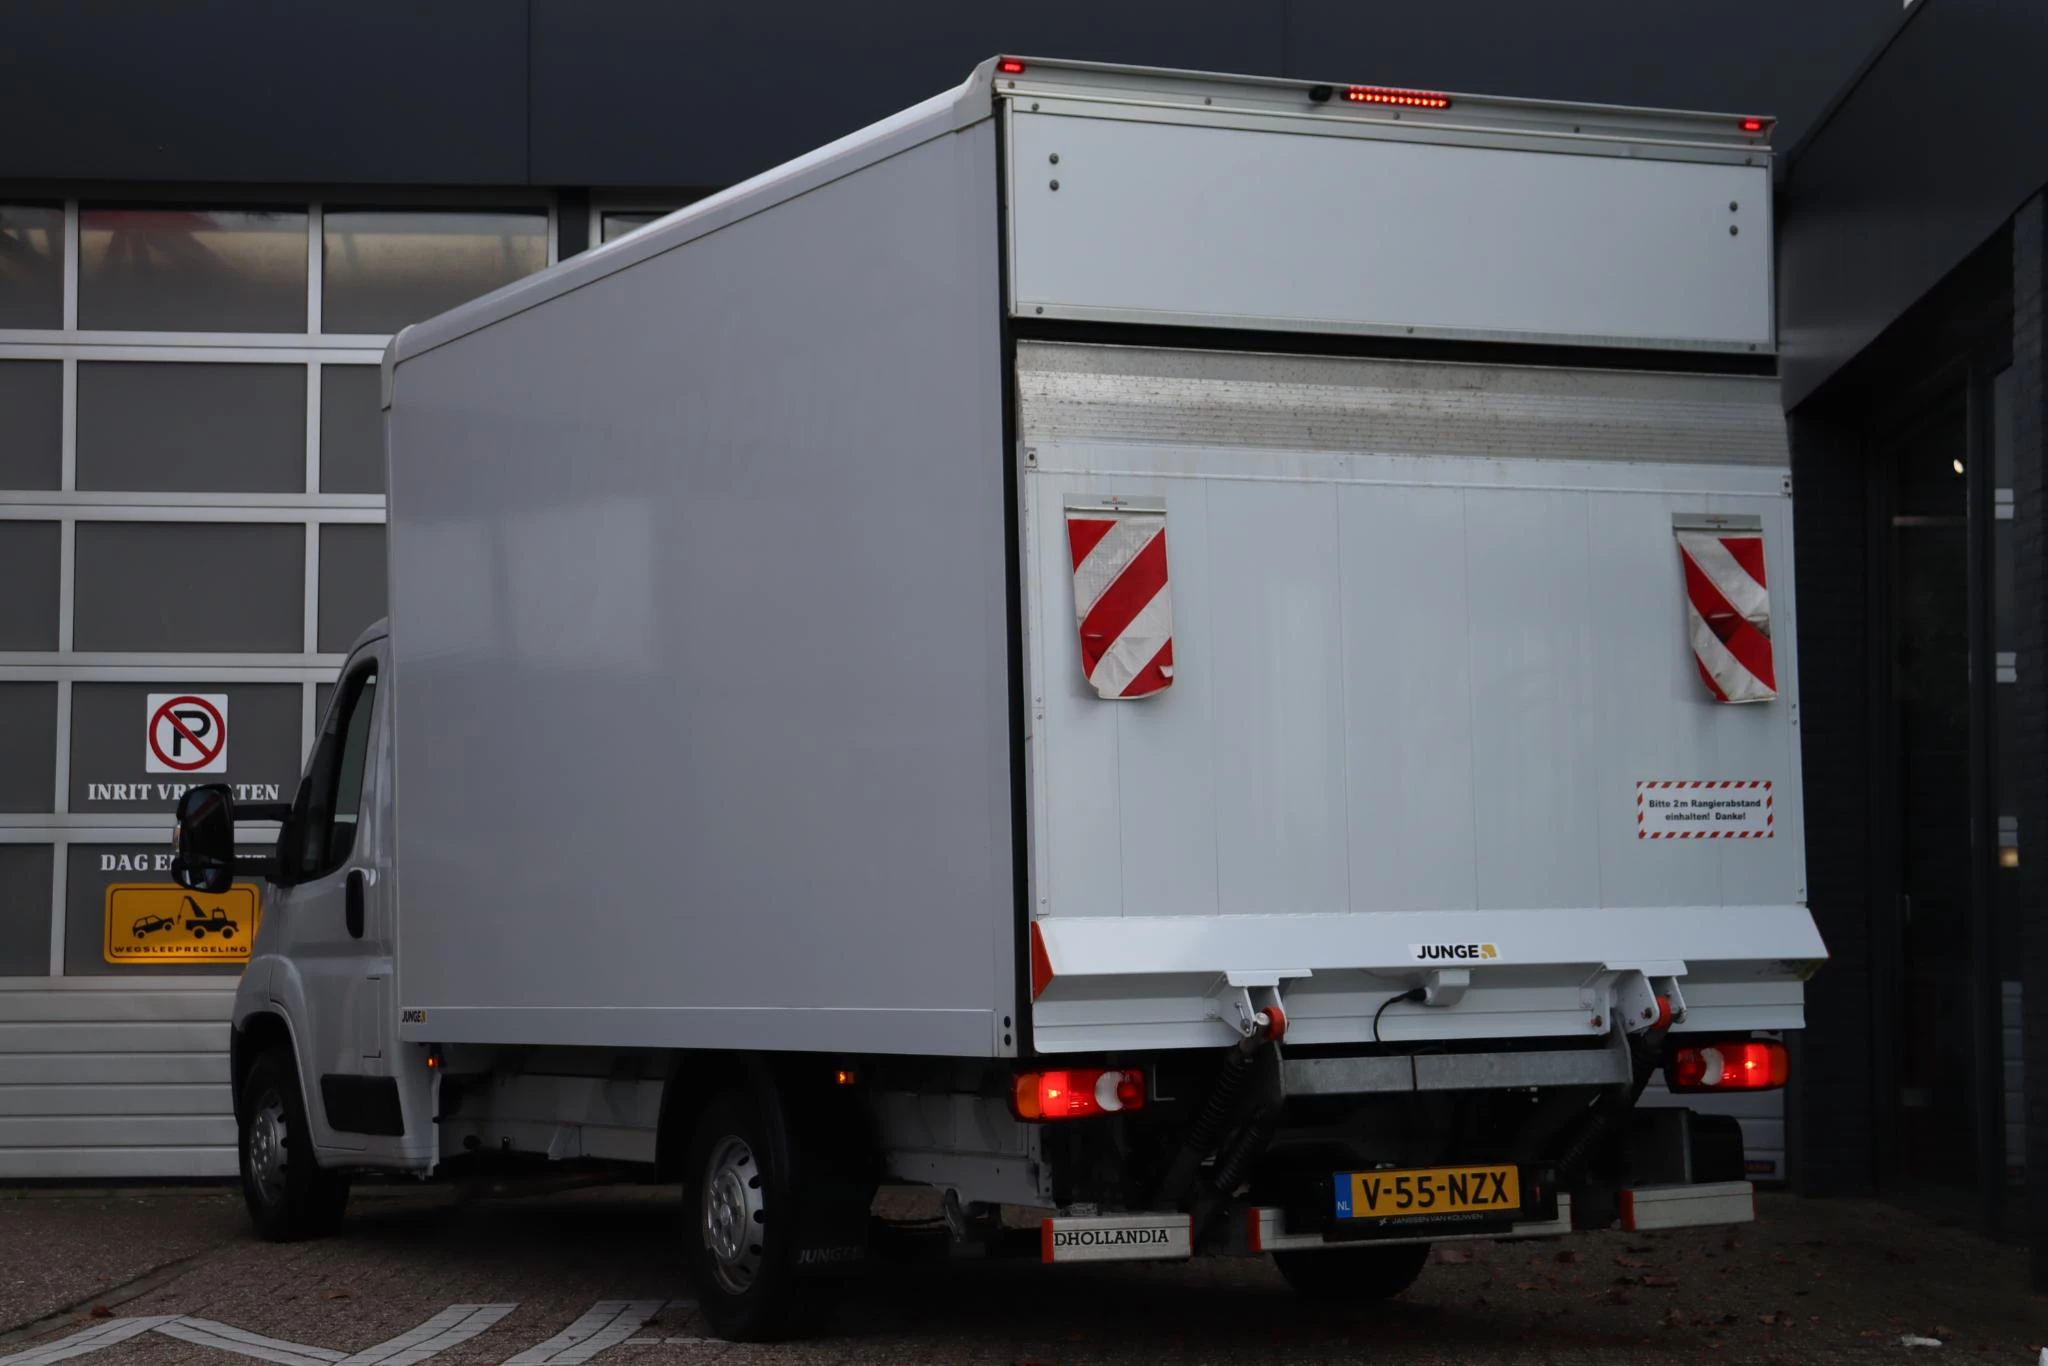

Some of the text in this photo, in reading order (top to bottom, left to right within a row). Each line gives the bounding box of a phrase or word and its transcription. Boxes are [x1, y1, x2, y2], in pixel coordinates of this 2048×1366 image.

[88, 783, 280, 801] INRIT VRTEN
[1649, 799, 1671, 808] Bitte
[1691, 799, 1761, 810] Rangierabstand
[1665, 812, 1746, 821] einhalten! Danke!
[100, 854, 149, 871] DAG
[1417, 944, 1480, 959] JUNGE
[401, 1010, 421, 1023] JUNGE
[1337, 1172, 1509, 1211] NL V-55-NZX
[1055, 1229, 1169, 1246] DHOLLANDIA
